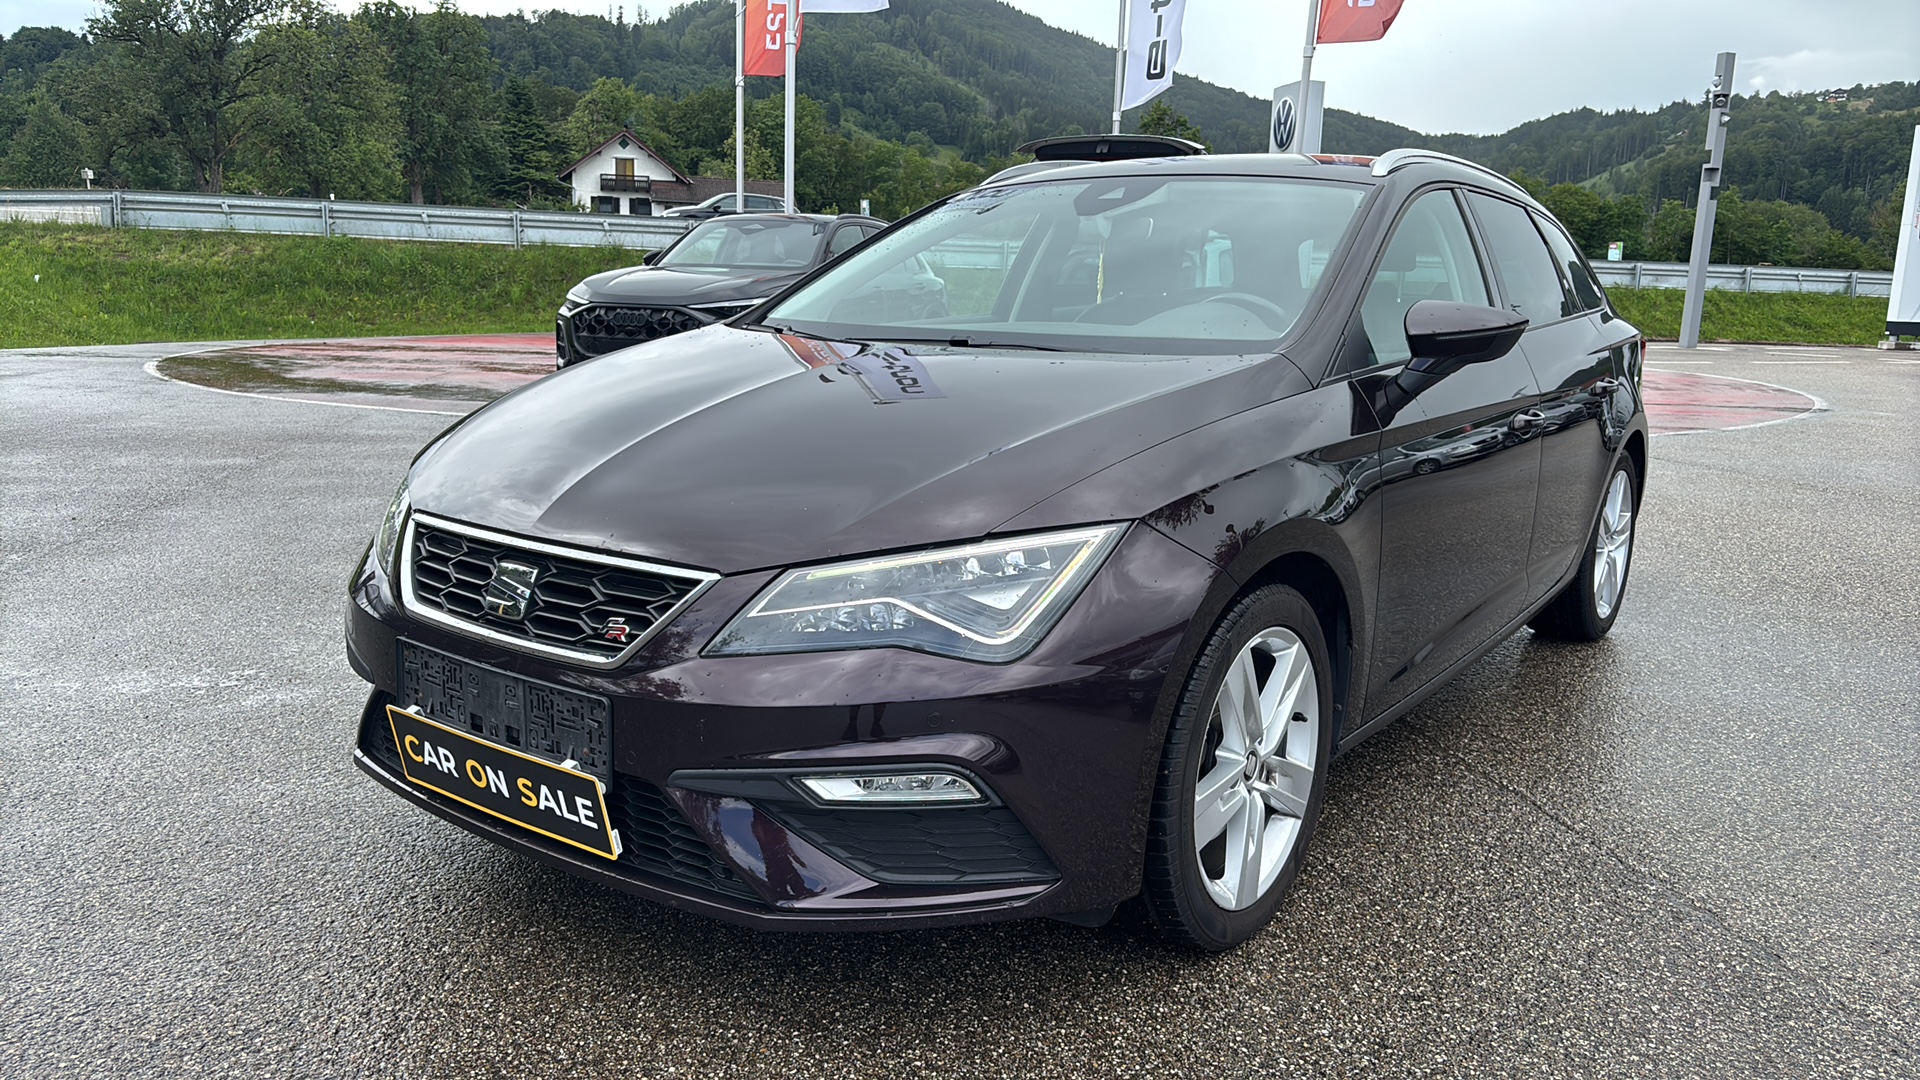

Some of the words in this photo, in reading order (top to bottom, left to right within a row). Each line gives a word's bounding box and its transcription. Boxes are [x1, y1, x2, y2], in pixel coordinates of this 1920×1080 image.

[597, 617, 630, 643] FR
[404, 734, 459, 778] CAR
[465, 758, 510, 798] ON
[516, 777, 599, 830] SALE
